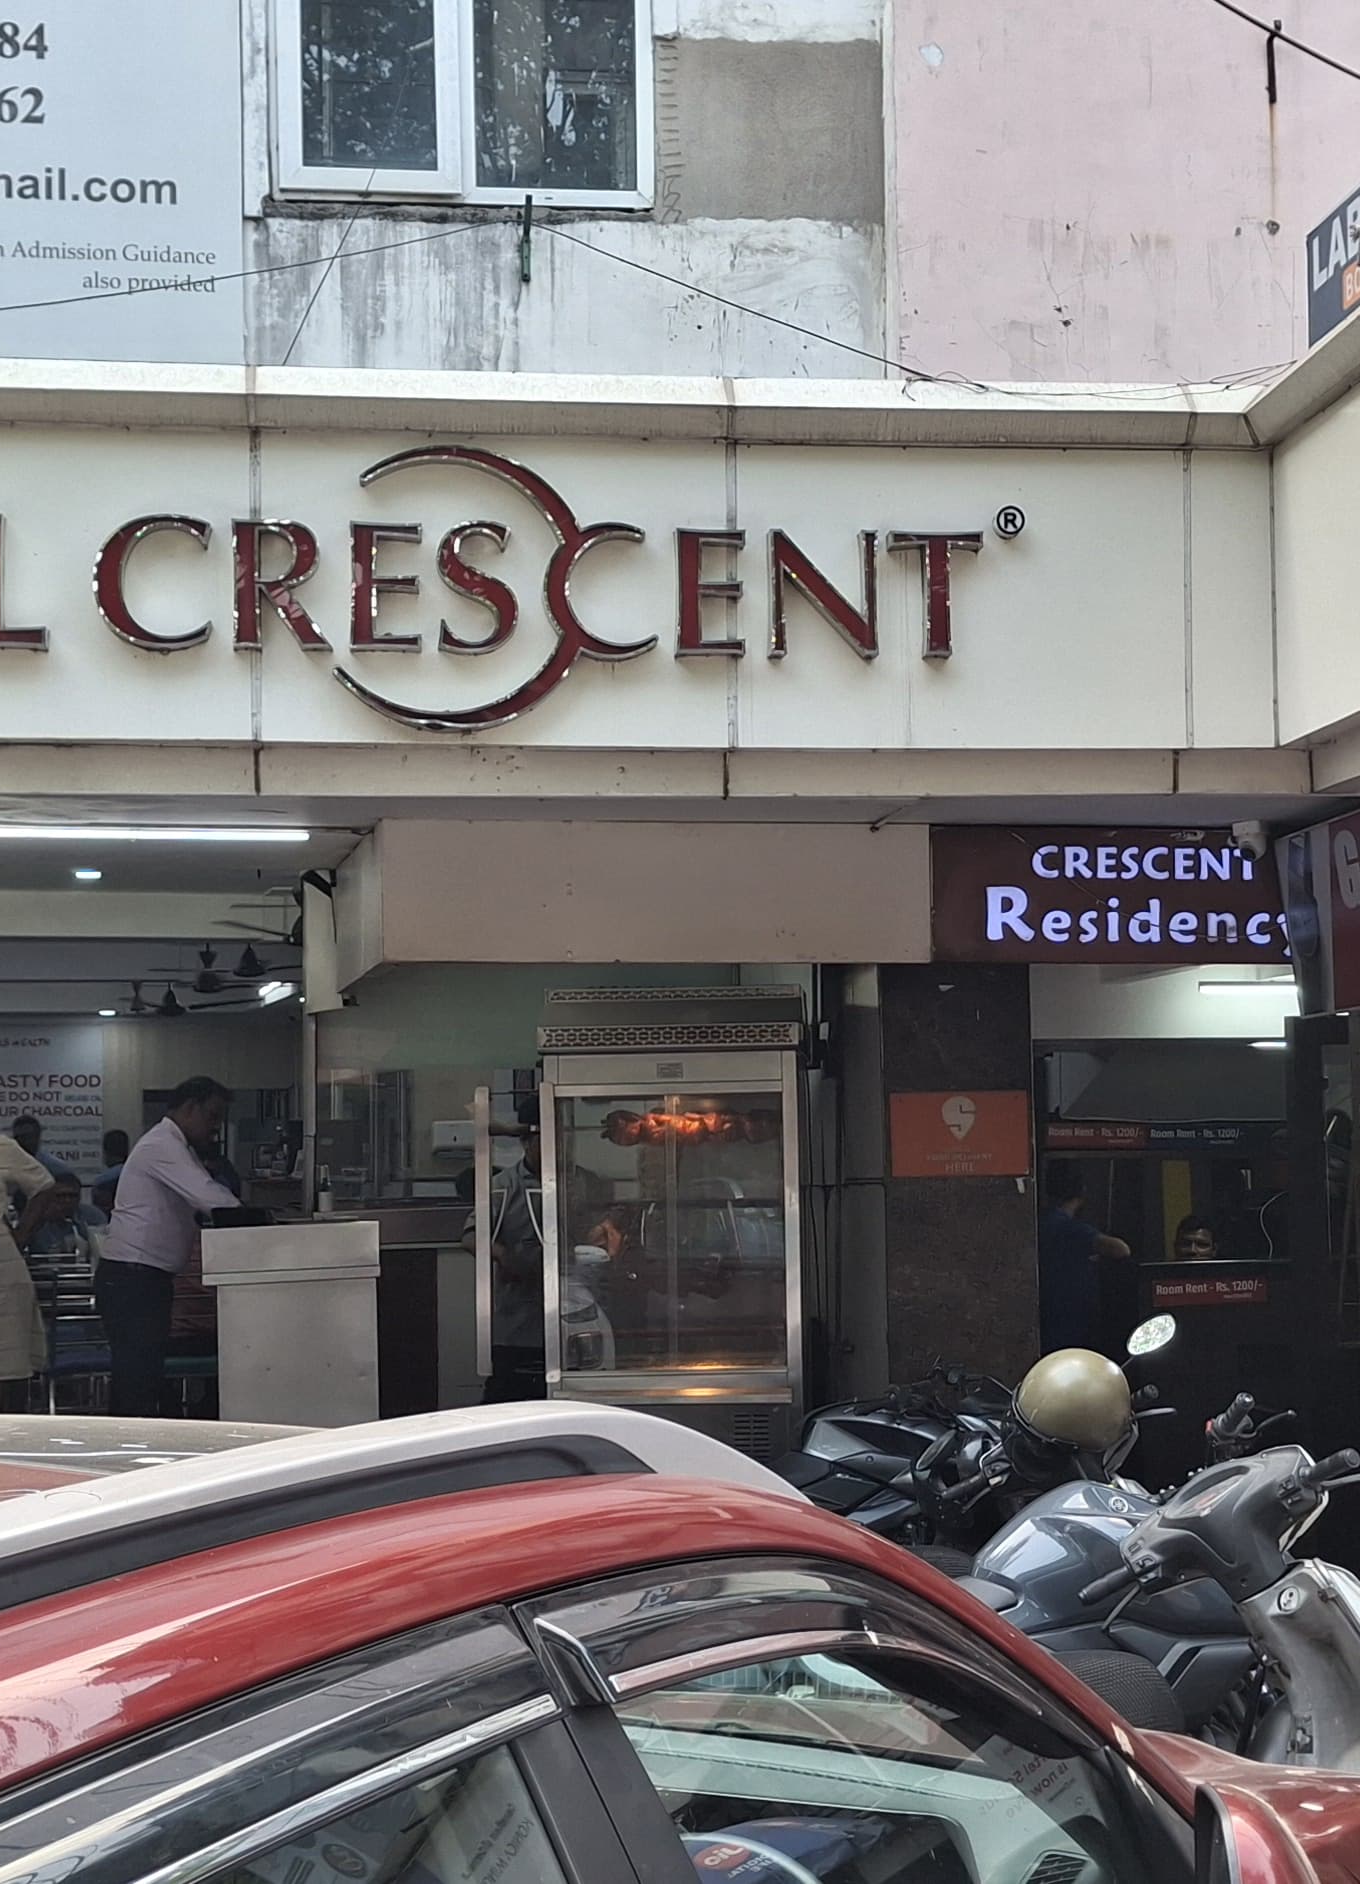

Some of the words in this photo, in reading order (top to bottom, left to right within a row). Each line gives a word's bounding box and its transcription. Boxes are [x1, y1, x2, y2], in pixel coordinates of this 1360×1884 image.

[11, 240, 117, 264] Admission
[122, 244, 216, 266] Guidance
[82, 271, 122, 290] also
[127, 273, 217, 297] provided
[1031, 844, 1256, 882] CRESCENT
[48, 1074, 102, 1089] FOOD
[9, 1091, 30, 1102] DO
[33, 1091, 63, 1102] NOT
[22, 1105, 103, 1118] CHARCOAL
[1048, 1126, 1073, 1137] Room
[1150, 1128, 1175, 1139] Room
[1156, 1284, 1184, 1296] Room
[1185, 1282, 1208, 1294] Rent
[1215, 1281, 1230, 1292] Rs.
[1232, 1279, 1264, 1292] 1200/-
